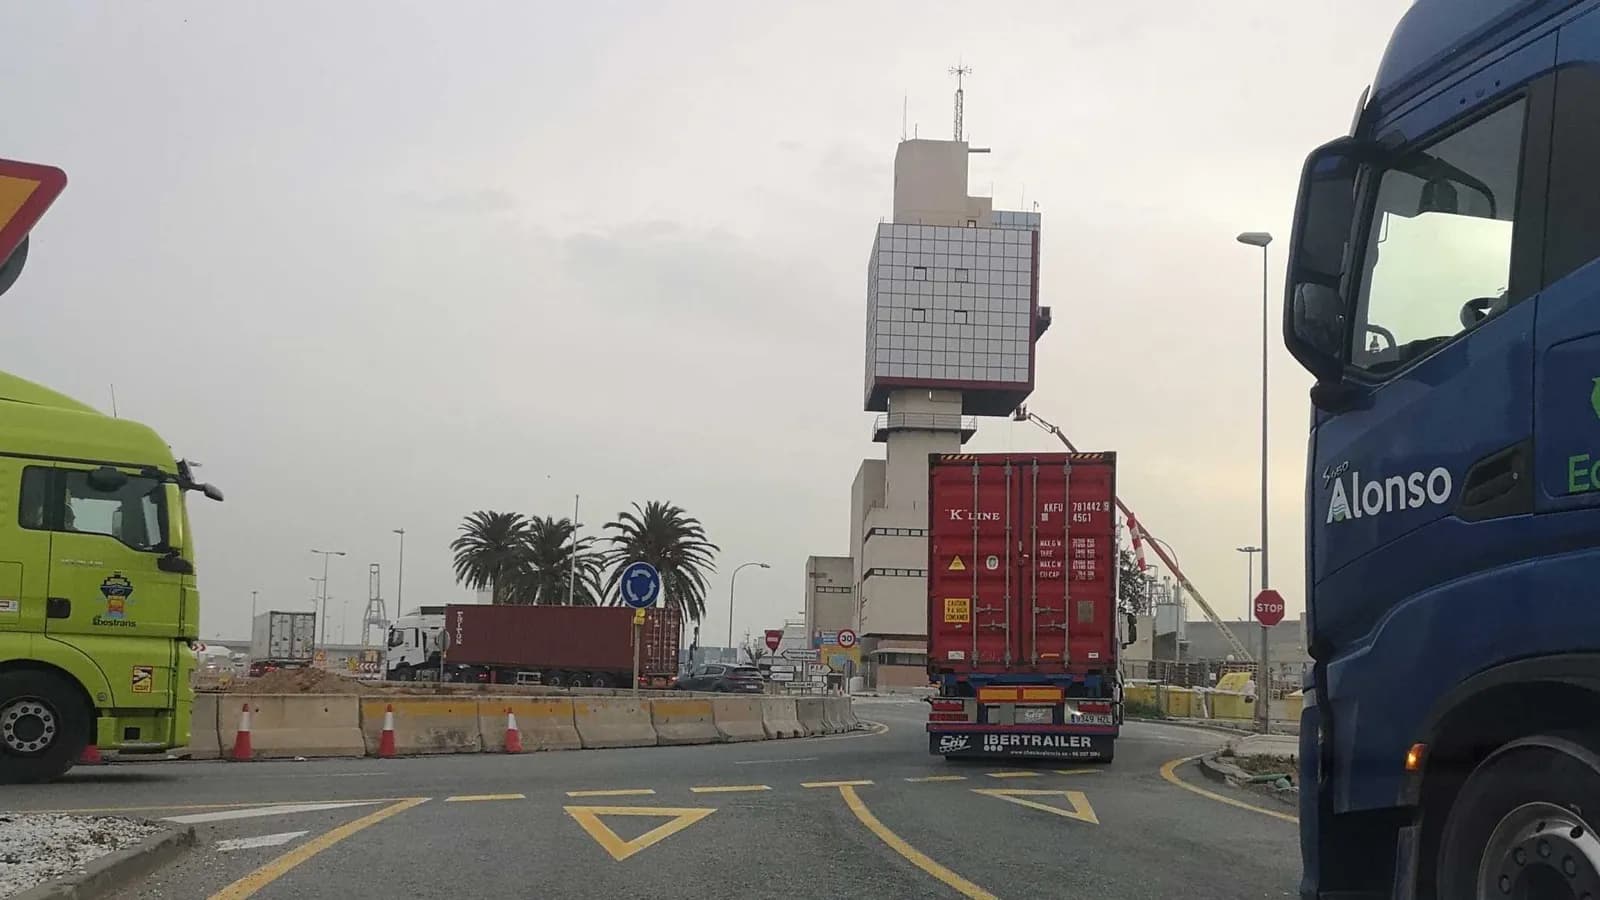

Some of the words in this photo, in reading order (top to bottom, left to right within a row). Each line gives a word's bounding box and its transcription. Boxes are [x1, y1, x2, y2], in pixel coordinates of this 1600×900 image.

[1326, 467, 1453, 524] Alonso
[1044, 503, 1064, 513] KKFU
[1072, 501, 1101, 512] 781442
[968, 512, 1000, 521] LINE
[1072, 513, 1092, 523] 45G1
[1256, 603, 1283, 613] STOP
[983, 734, 1092, 747] IBERTRAILER
